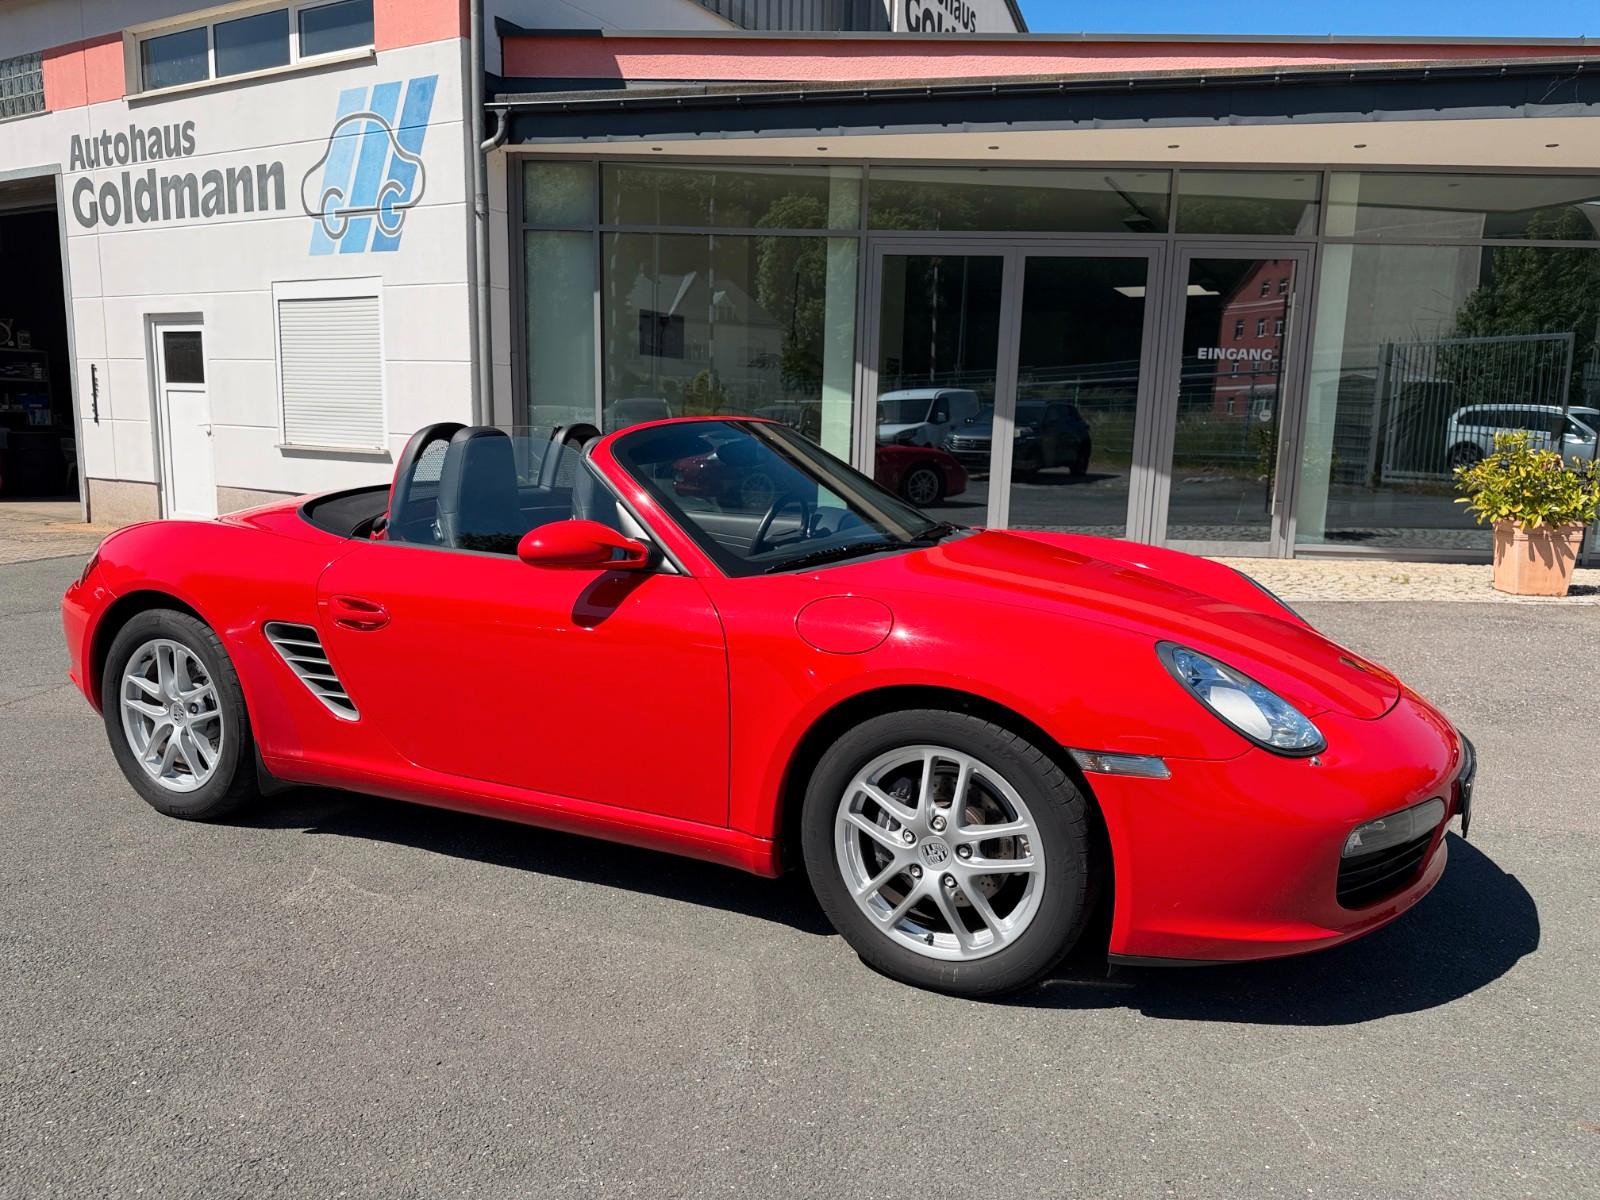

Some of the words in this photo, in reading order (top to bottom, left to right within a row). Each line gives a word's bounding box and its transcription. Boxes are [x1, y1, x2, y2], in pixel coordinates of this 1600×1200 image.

[905, 0, 957, 32] Gol
[69, 120, 196, 171] Autohaus
[72, 160, 286, 229] Goldmann
[1197, 347, 1273, 361] EINGANG
